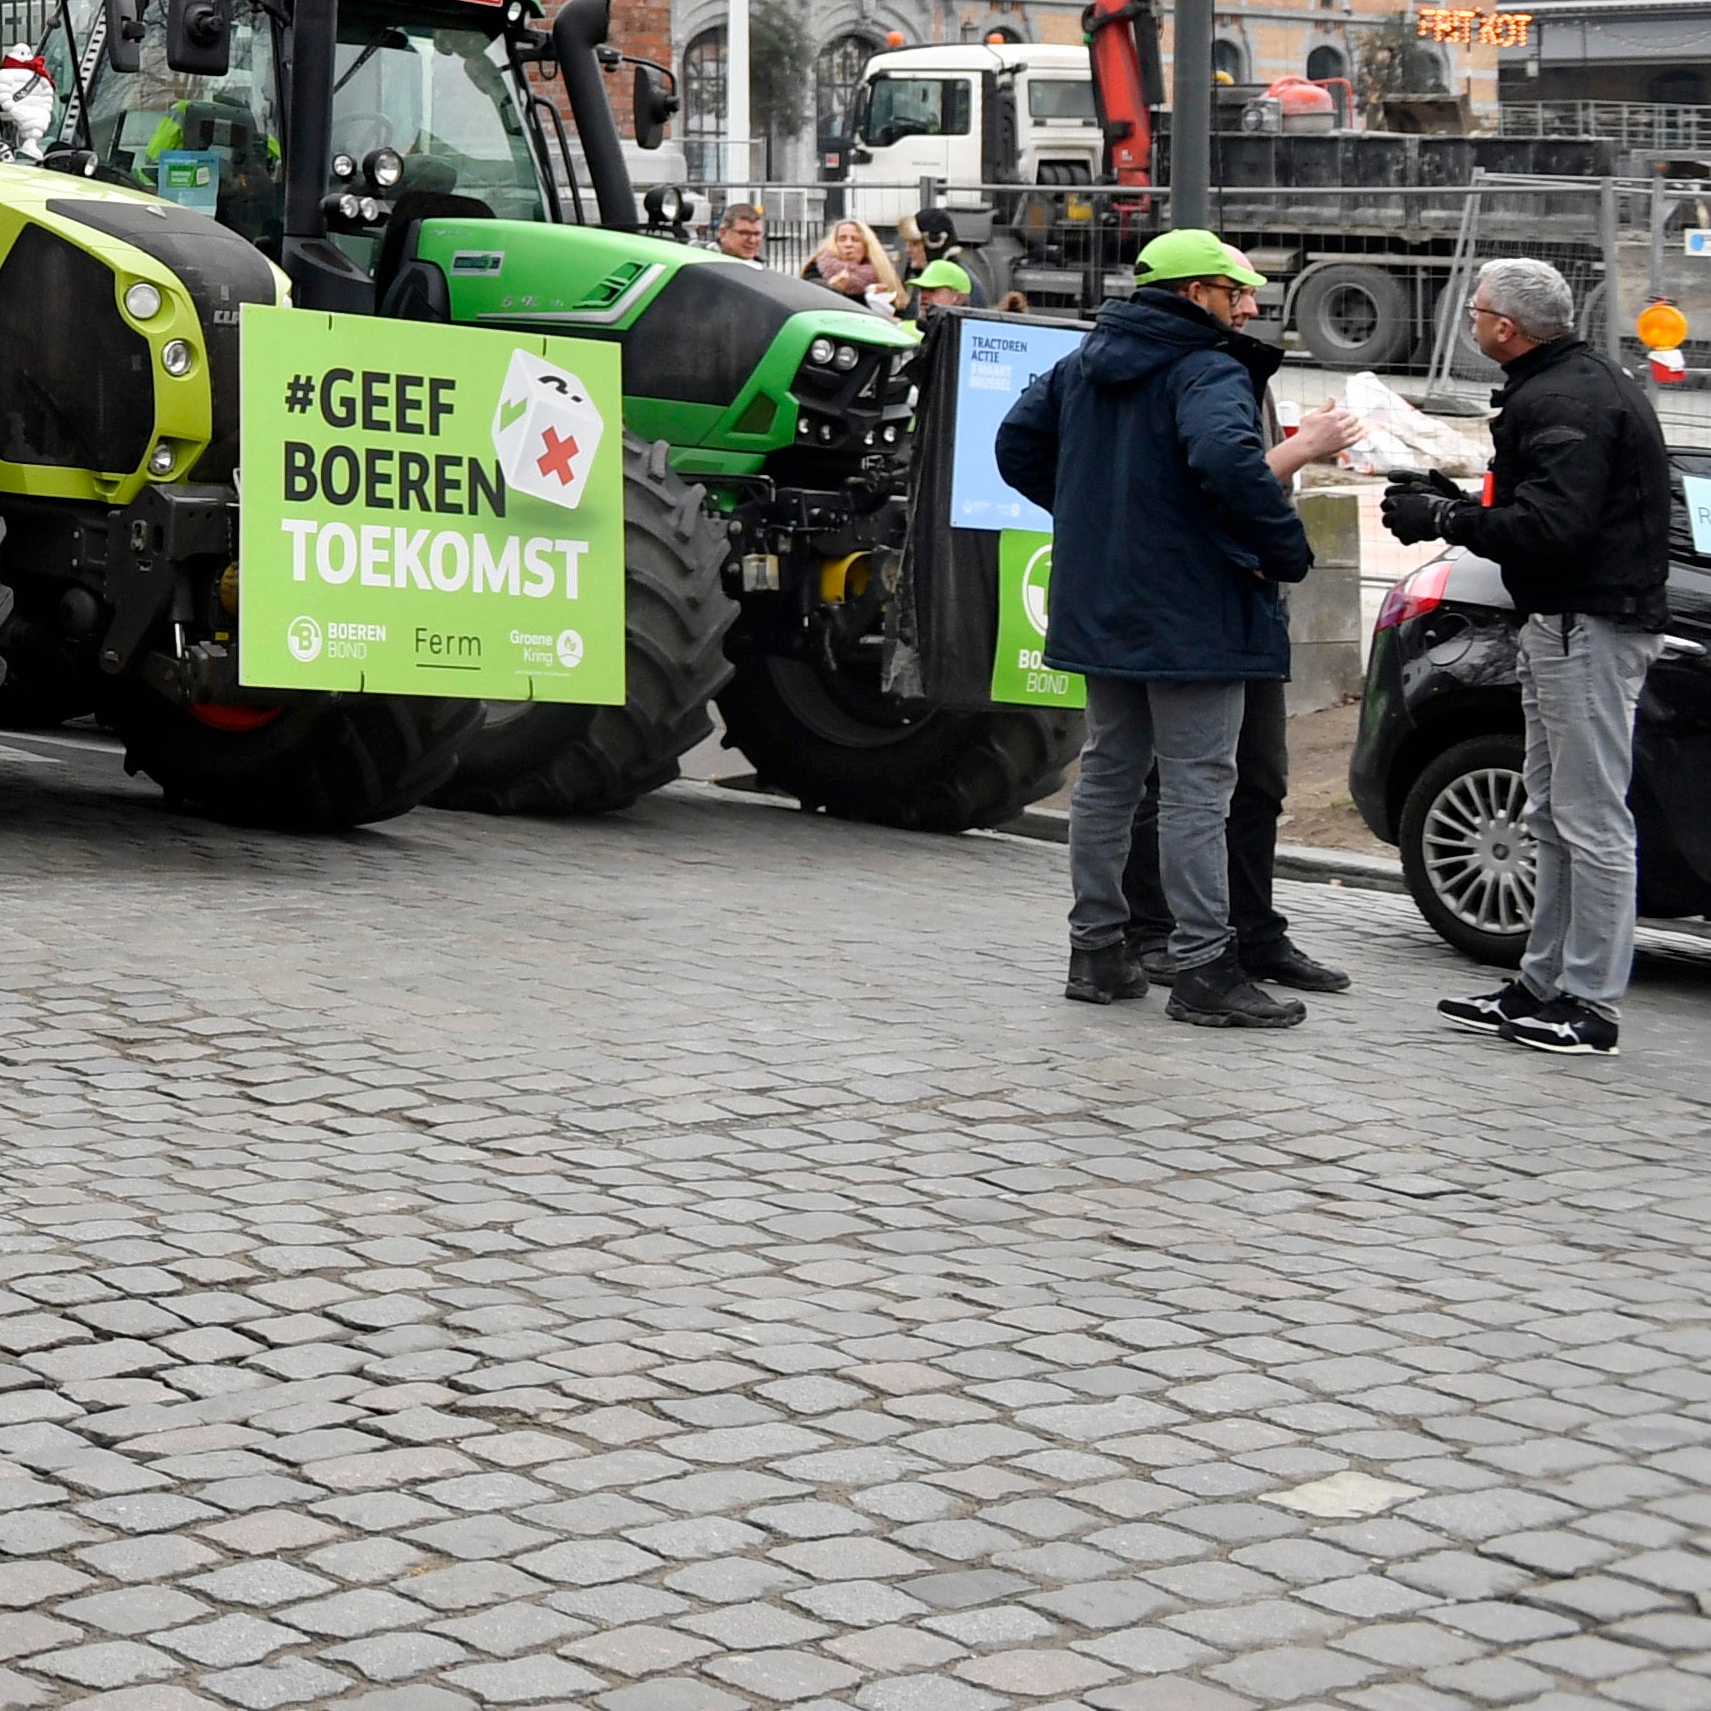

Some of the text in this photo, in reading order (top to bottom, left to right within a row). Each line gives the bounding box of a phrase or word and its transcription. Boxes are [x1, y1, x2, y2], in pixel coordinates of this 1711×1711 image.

[972, 336, 1028, 353] TRACTOREN
[971, 349, 1000, 364] ACTIE
[284, 367, 457, 437] #GEEF
[282, 440, 507, 519] BOEREN
[281, 518, 590, 601] TOEKOMST
[327, 622, 387, 642] BOEREN
[414, 628, 482, 656] Ferm
[509, 630, 554, 647] Groene
[327, 640, 368, 659] BOND
[523, 646, 554, 667] Kring
[1026, 671, 1070, 695] BOND
